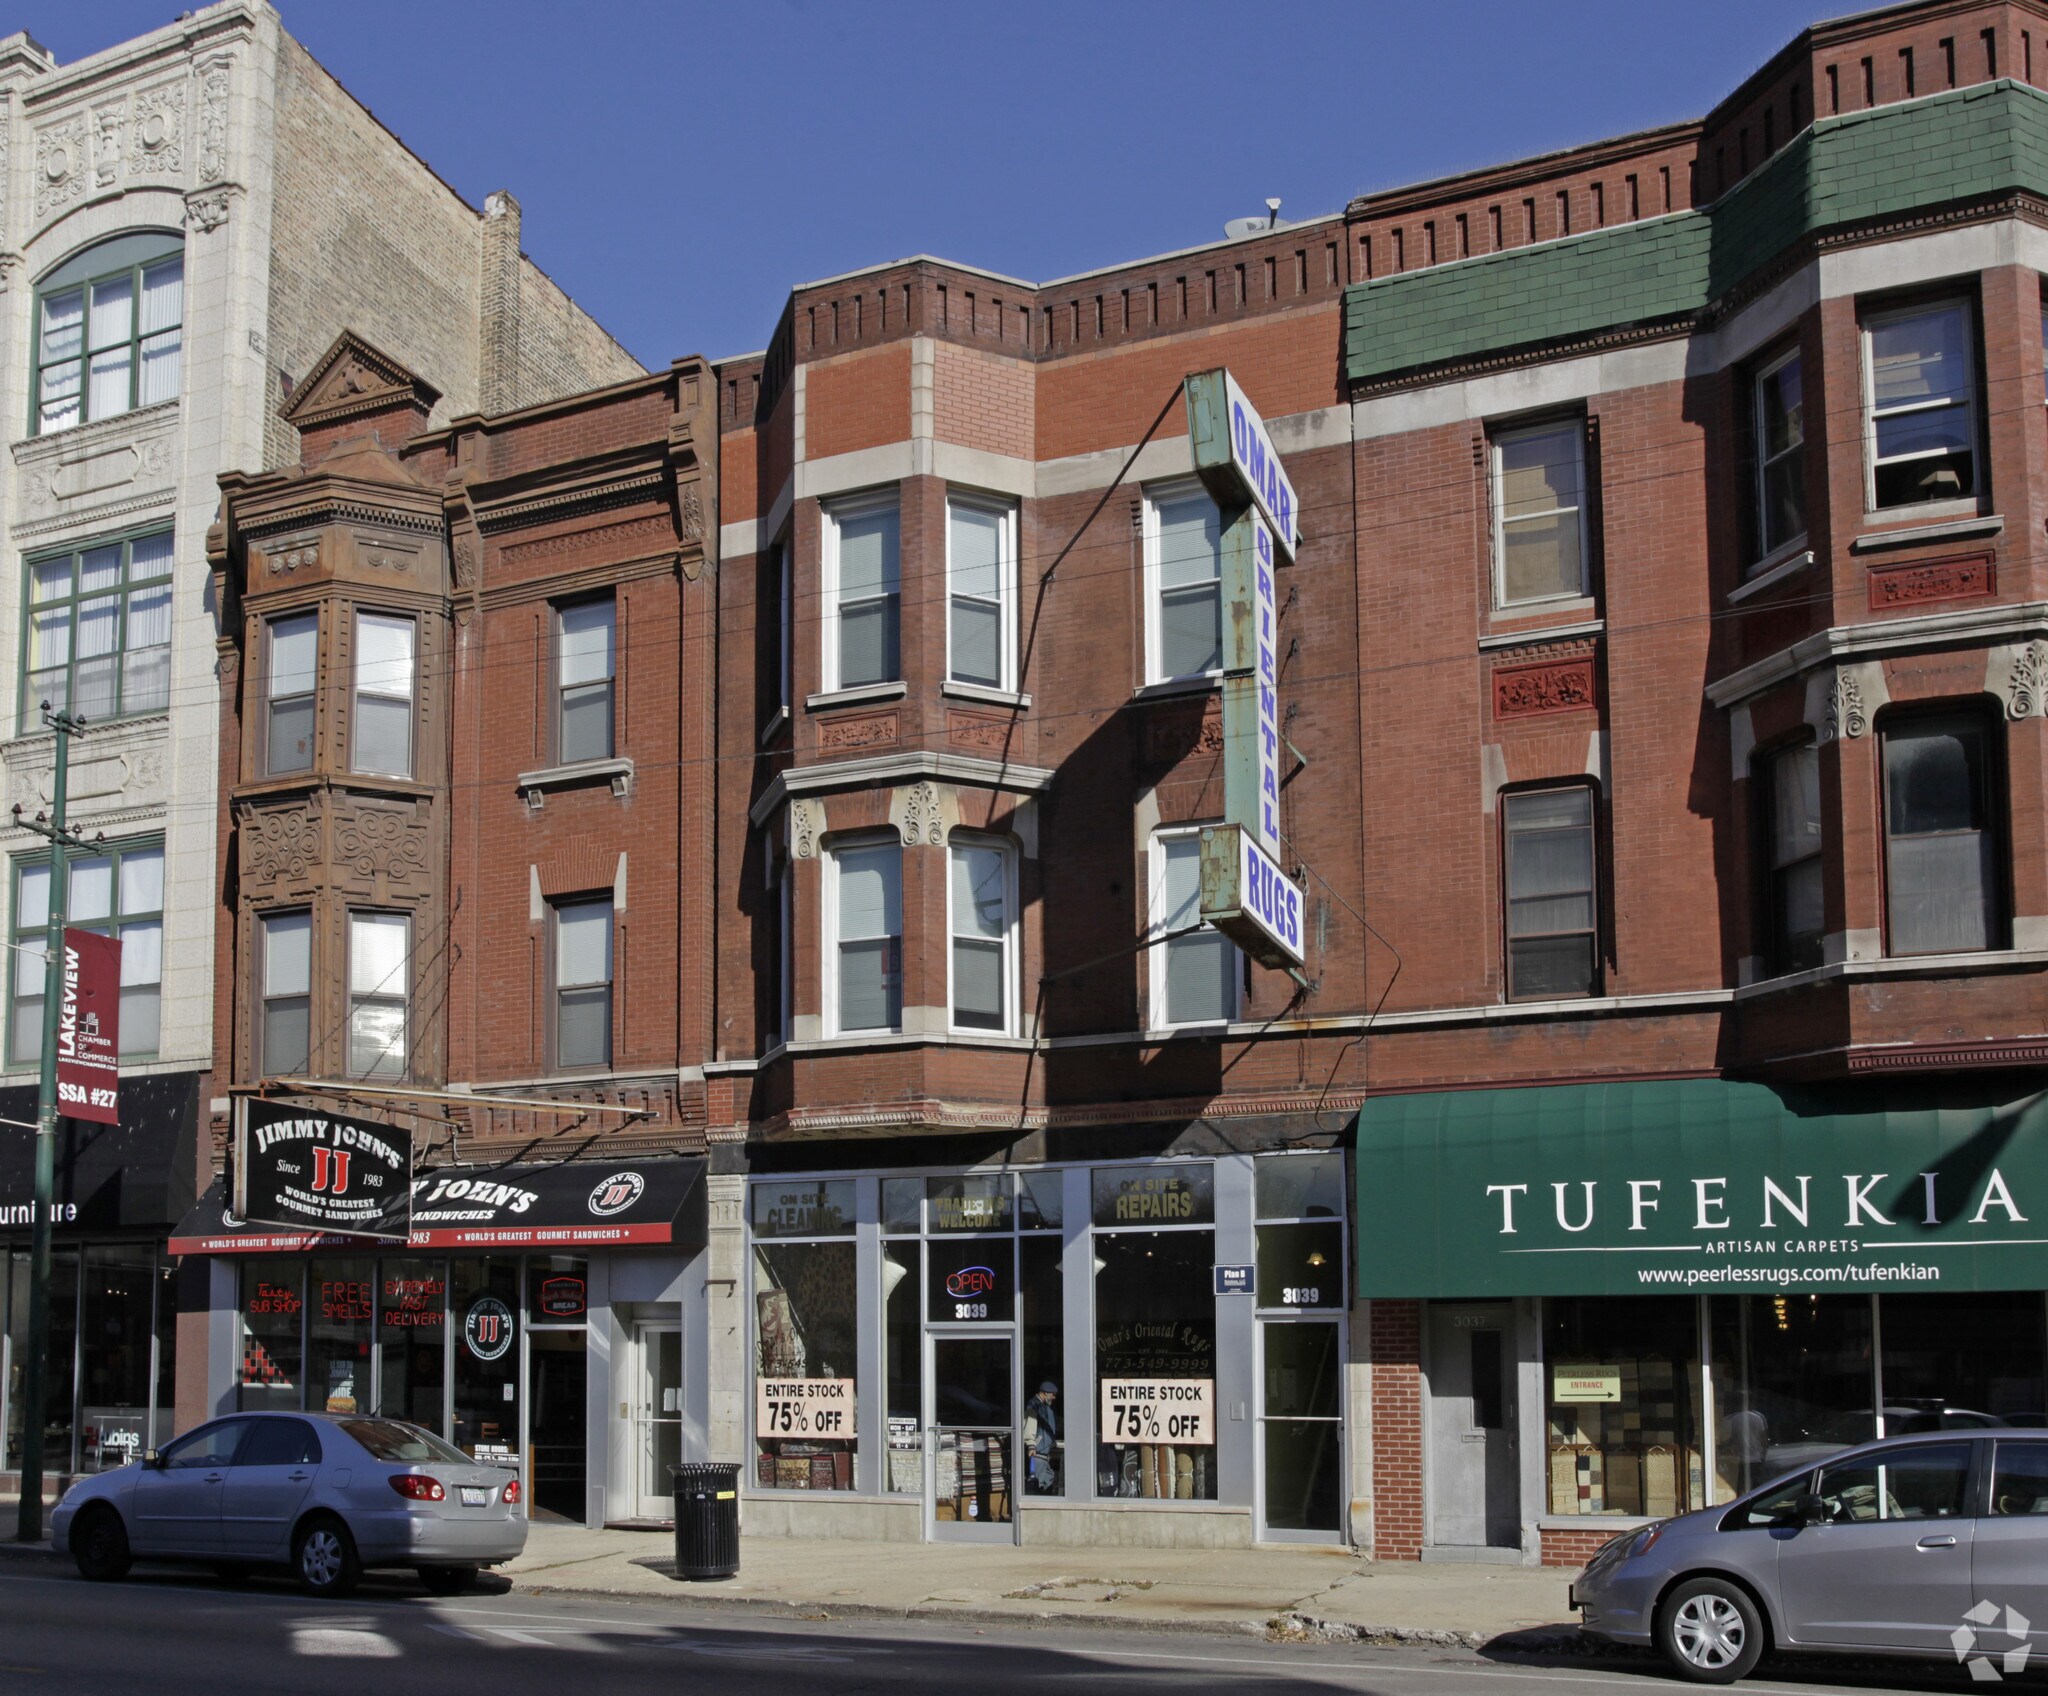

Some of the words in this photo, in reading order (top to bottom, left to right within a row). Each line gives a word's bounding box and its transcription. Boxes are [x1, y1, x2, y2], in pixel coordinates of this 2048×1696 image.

[1233, 400, 1292, 545] OMAR
[1257, 526, 1278, 842] ORIENTAL
[1247, 845, 1298, 948] RUGS
[59, 946, 80, 1057] LAKEVIEW
[78, 1035, 112, 1047] CHAMBER
[77, 1051, 117, 1065] COMMERCE
[58, 1082, 88, 1104] SSA
[90, 1089, 117, 1109] #27
[255, 1119, 329, 1154] JIMMY
[333, 1123, 401, 1170] JOHN'S
[276, 1159, 301, 1174] Since
[312, 1146, 352, 1195] JJ
[362, 1174, 384, 1187] 1983
[1120, 1181, 1140, 1191] ON
[1145, 1178, 1179, 1191] SITE
[284, 1185, 327, 1206] WORLD'S
[329, 1198, 375, 1209] GREATEST
[427, 1179, 539, 1213] JOHN'S
[599, 1184, 633, 1206] JJ
[780, 1195, 797, 1206] ON
[801, 1193, 831, 1204] SITE
[1486, 1168, 2029, 1234] TUFENKIA
[275, 1194, 323, 1218] GOURMET
[325, 1208, 384, 1221] SANDWICHES
[1116, 1192, 1192, 1219] REPAIRS
[411, 1209, 496, 1222] ANDWICHES
[767, 1206, 843, 1230] CLEANING
[940, 1213, 1001, 1228] WELCOME
[208, 1239, 236, 1249] WORLD'S
[237, 1238, 267, 1248] GREATEST
[271, 1237, 301, 1247] GOURMET
[302, 1235, 344, 1246] SANDWICHES
[464, 1232, 496, 1242] WORLD'S
[497, 1231, 532, 1241] GREATEST
[536, 1230, 571, 1240] GOURMET
[573, 1229, 621, 1239] SANDWICHES
[1705, 1240, 1776, 1254] ARTISAN
[1784, 1239, 1859, 1254] CARPETS
[946, 1273, 993, 1291] OPEN
[1224, 1270, 1240, 1278] Plan
[1240, 1270, 1246, 1278] B
[1637, 1263, 1940, 1286] www.peerlessrugs.com/tufenkian
[257, 1283, 295, 1300] Tasty
[321, 1282, 372, 1304] FREE
[385, 1280, 446, 1295] EXTREMELY
[1283, 1287, 1319, 1304] 3039
[250, 1300, 270, 1313] SUB
[273, 1300, 301, 1313] SHOP
[321, 1302, 372, 1319] SMELLS
[400, 1295, 429, 1311] FAST
[955, 1303, 987, 1318] 3039
[385, 1312, 445, 1326] DELIVERY
[468, 1301, 488, 1329] JIMMY
[489, 1301, 510, 1329] JOHN'S
[1454, 1315, 1488, 1328] 3037
[478, 1315, 500, 1342] JJ
[1097, 1325, 1131, 1352] Omar's
[1135, 1321, 1179, 1339] Oriental
[1180, 1326, 1211, 1352] Rugs
[1104, 1357, 1210, 1370] 773-549-9999
[1557, 1369, 1596, 1378] PEERLESS
[1596, 1369, 1617, 1378] RUGS
[765, 1384, 804, 1397] ENTIRE
[807, 1384, 845, 1398] STOCK
[1110, 1386, 1155, 1400] ENTIRE
[1159, 1386, 1202, 1401] STOCK
[1570, 1381, 1604, 1389] ENTRANCE
[768, 1401, 808, 1432] 75%
[815, 1410, 843, 1432] OFF
[1113, 1404, 1160, 1437] 75%
[1168, 1414, 1200, 1438] OFF
